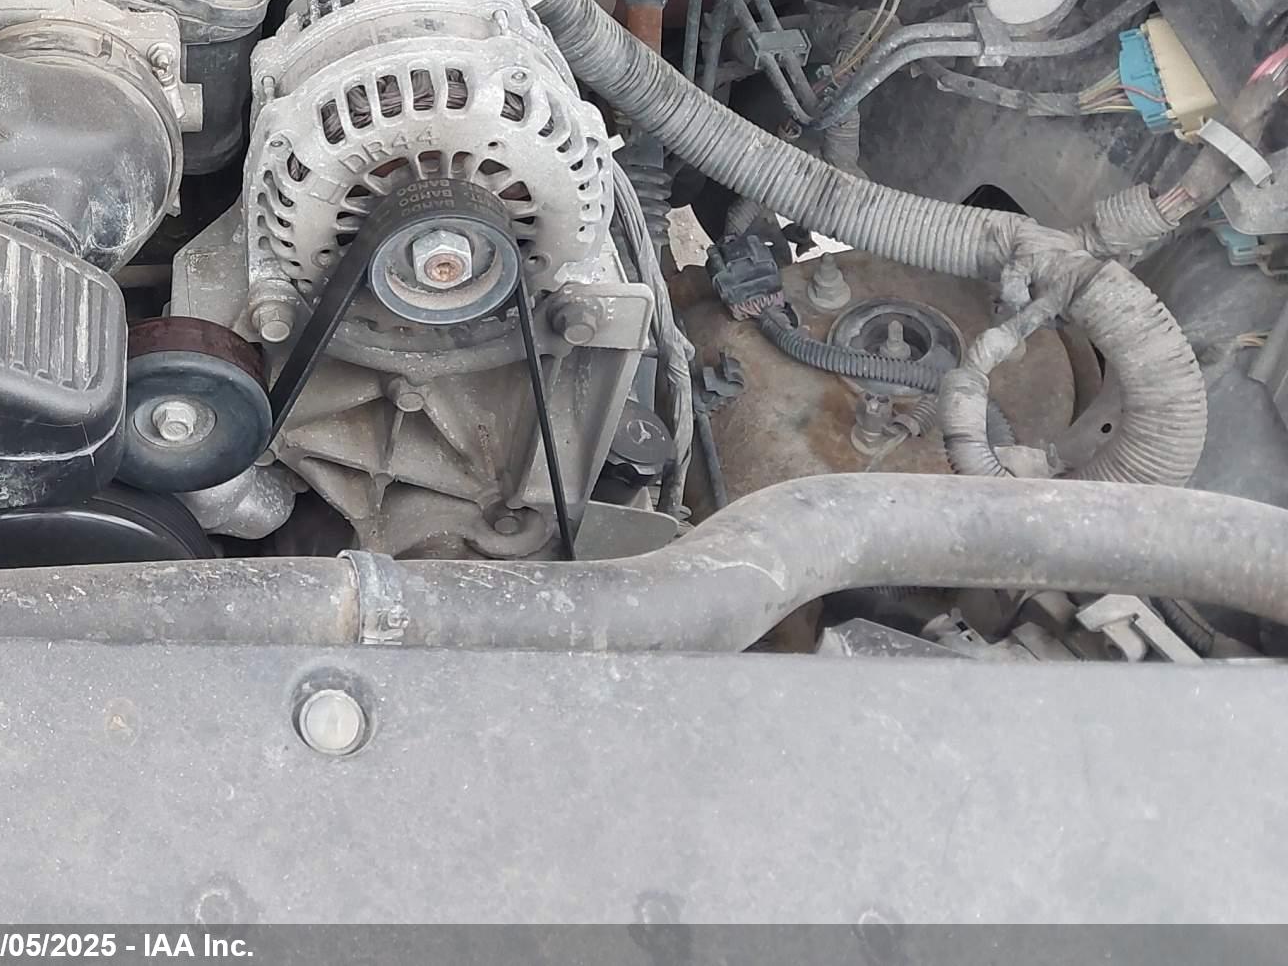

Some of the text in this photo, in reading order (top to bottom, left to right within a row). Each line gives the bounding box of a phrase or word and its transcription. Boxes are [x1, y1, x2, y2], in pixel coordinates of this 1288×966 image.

[338, 124, 440, 174] DR44
[397, 179, 450, 197] BANDO
[399, 189, 453, 206] BANDO
